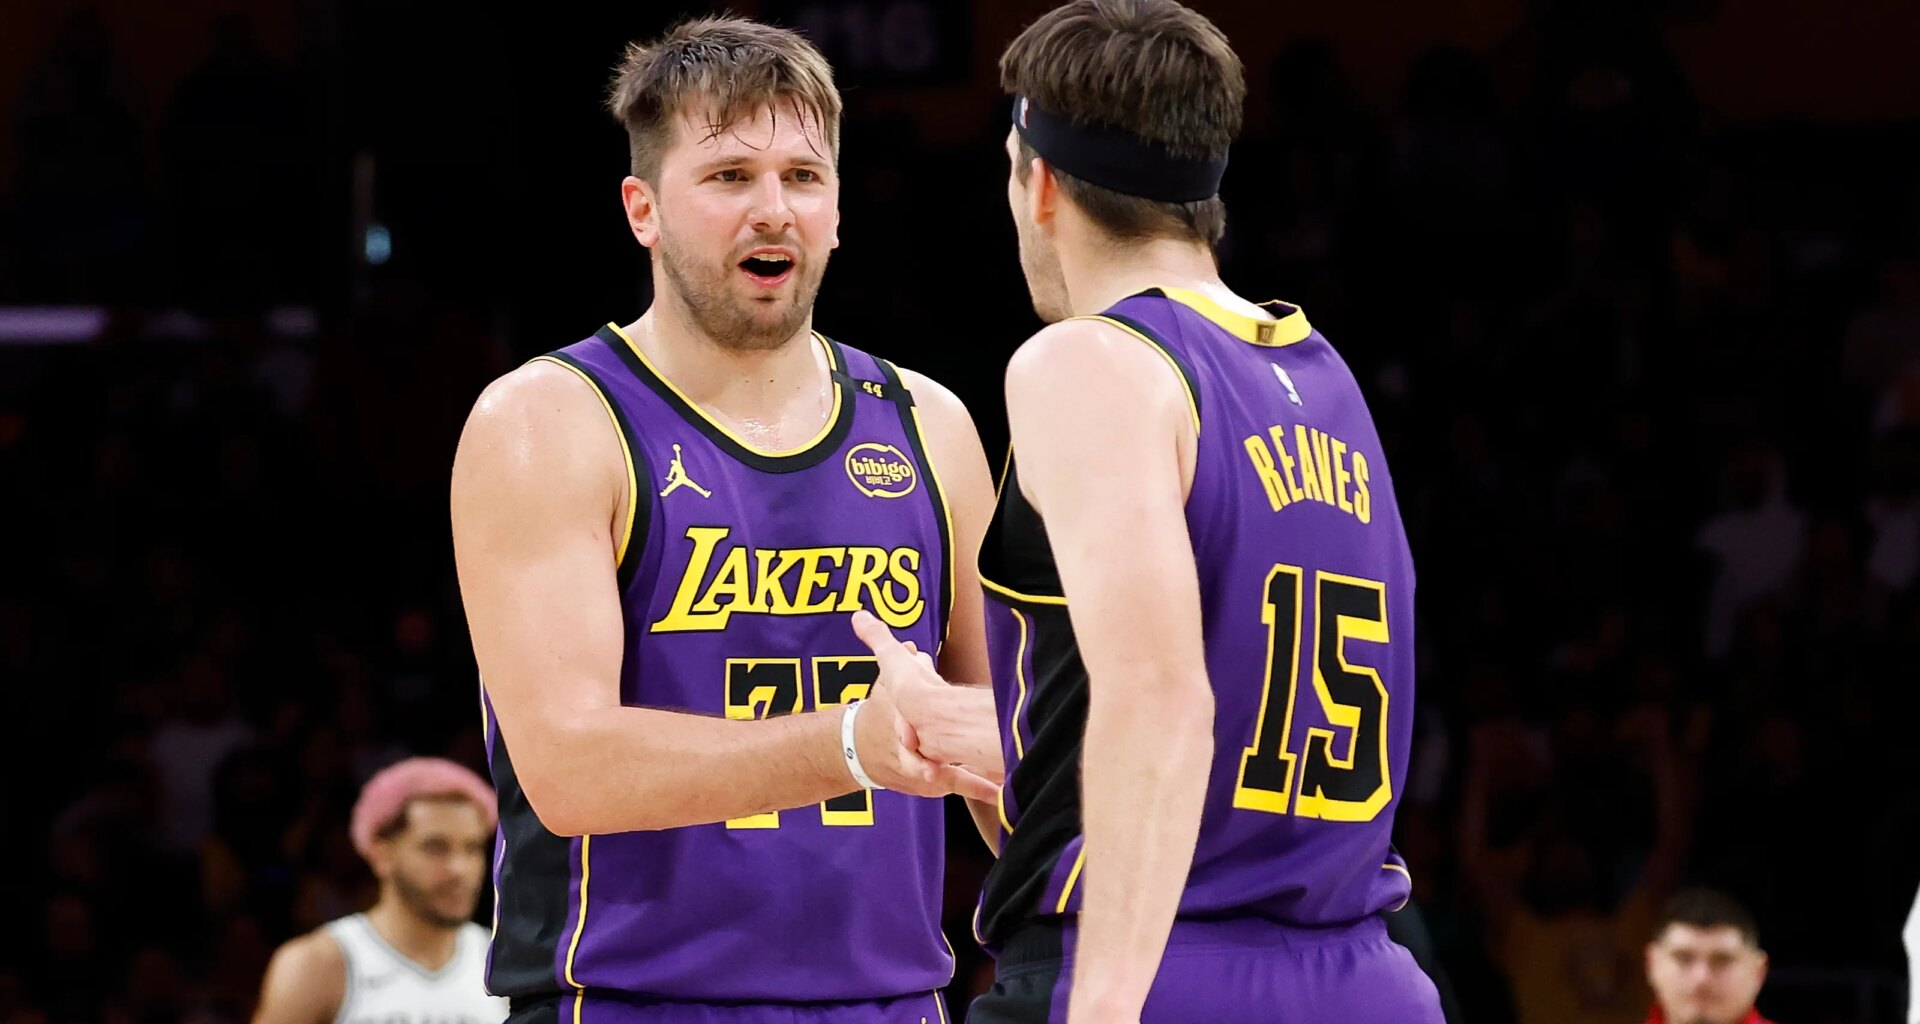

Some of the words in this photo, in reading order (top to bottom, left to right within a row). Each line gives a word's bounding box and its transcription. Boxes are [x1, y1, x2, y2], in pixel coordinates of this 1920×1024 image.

[862, 381, 884, 398] 44
[850, 457, 912, 483] bibigo
[1244, 424, 1371, 525] REAVES
[650, 526, 926, 634] LAKERS
[1233, 563, 1393, 822] 15
